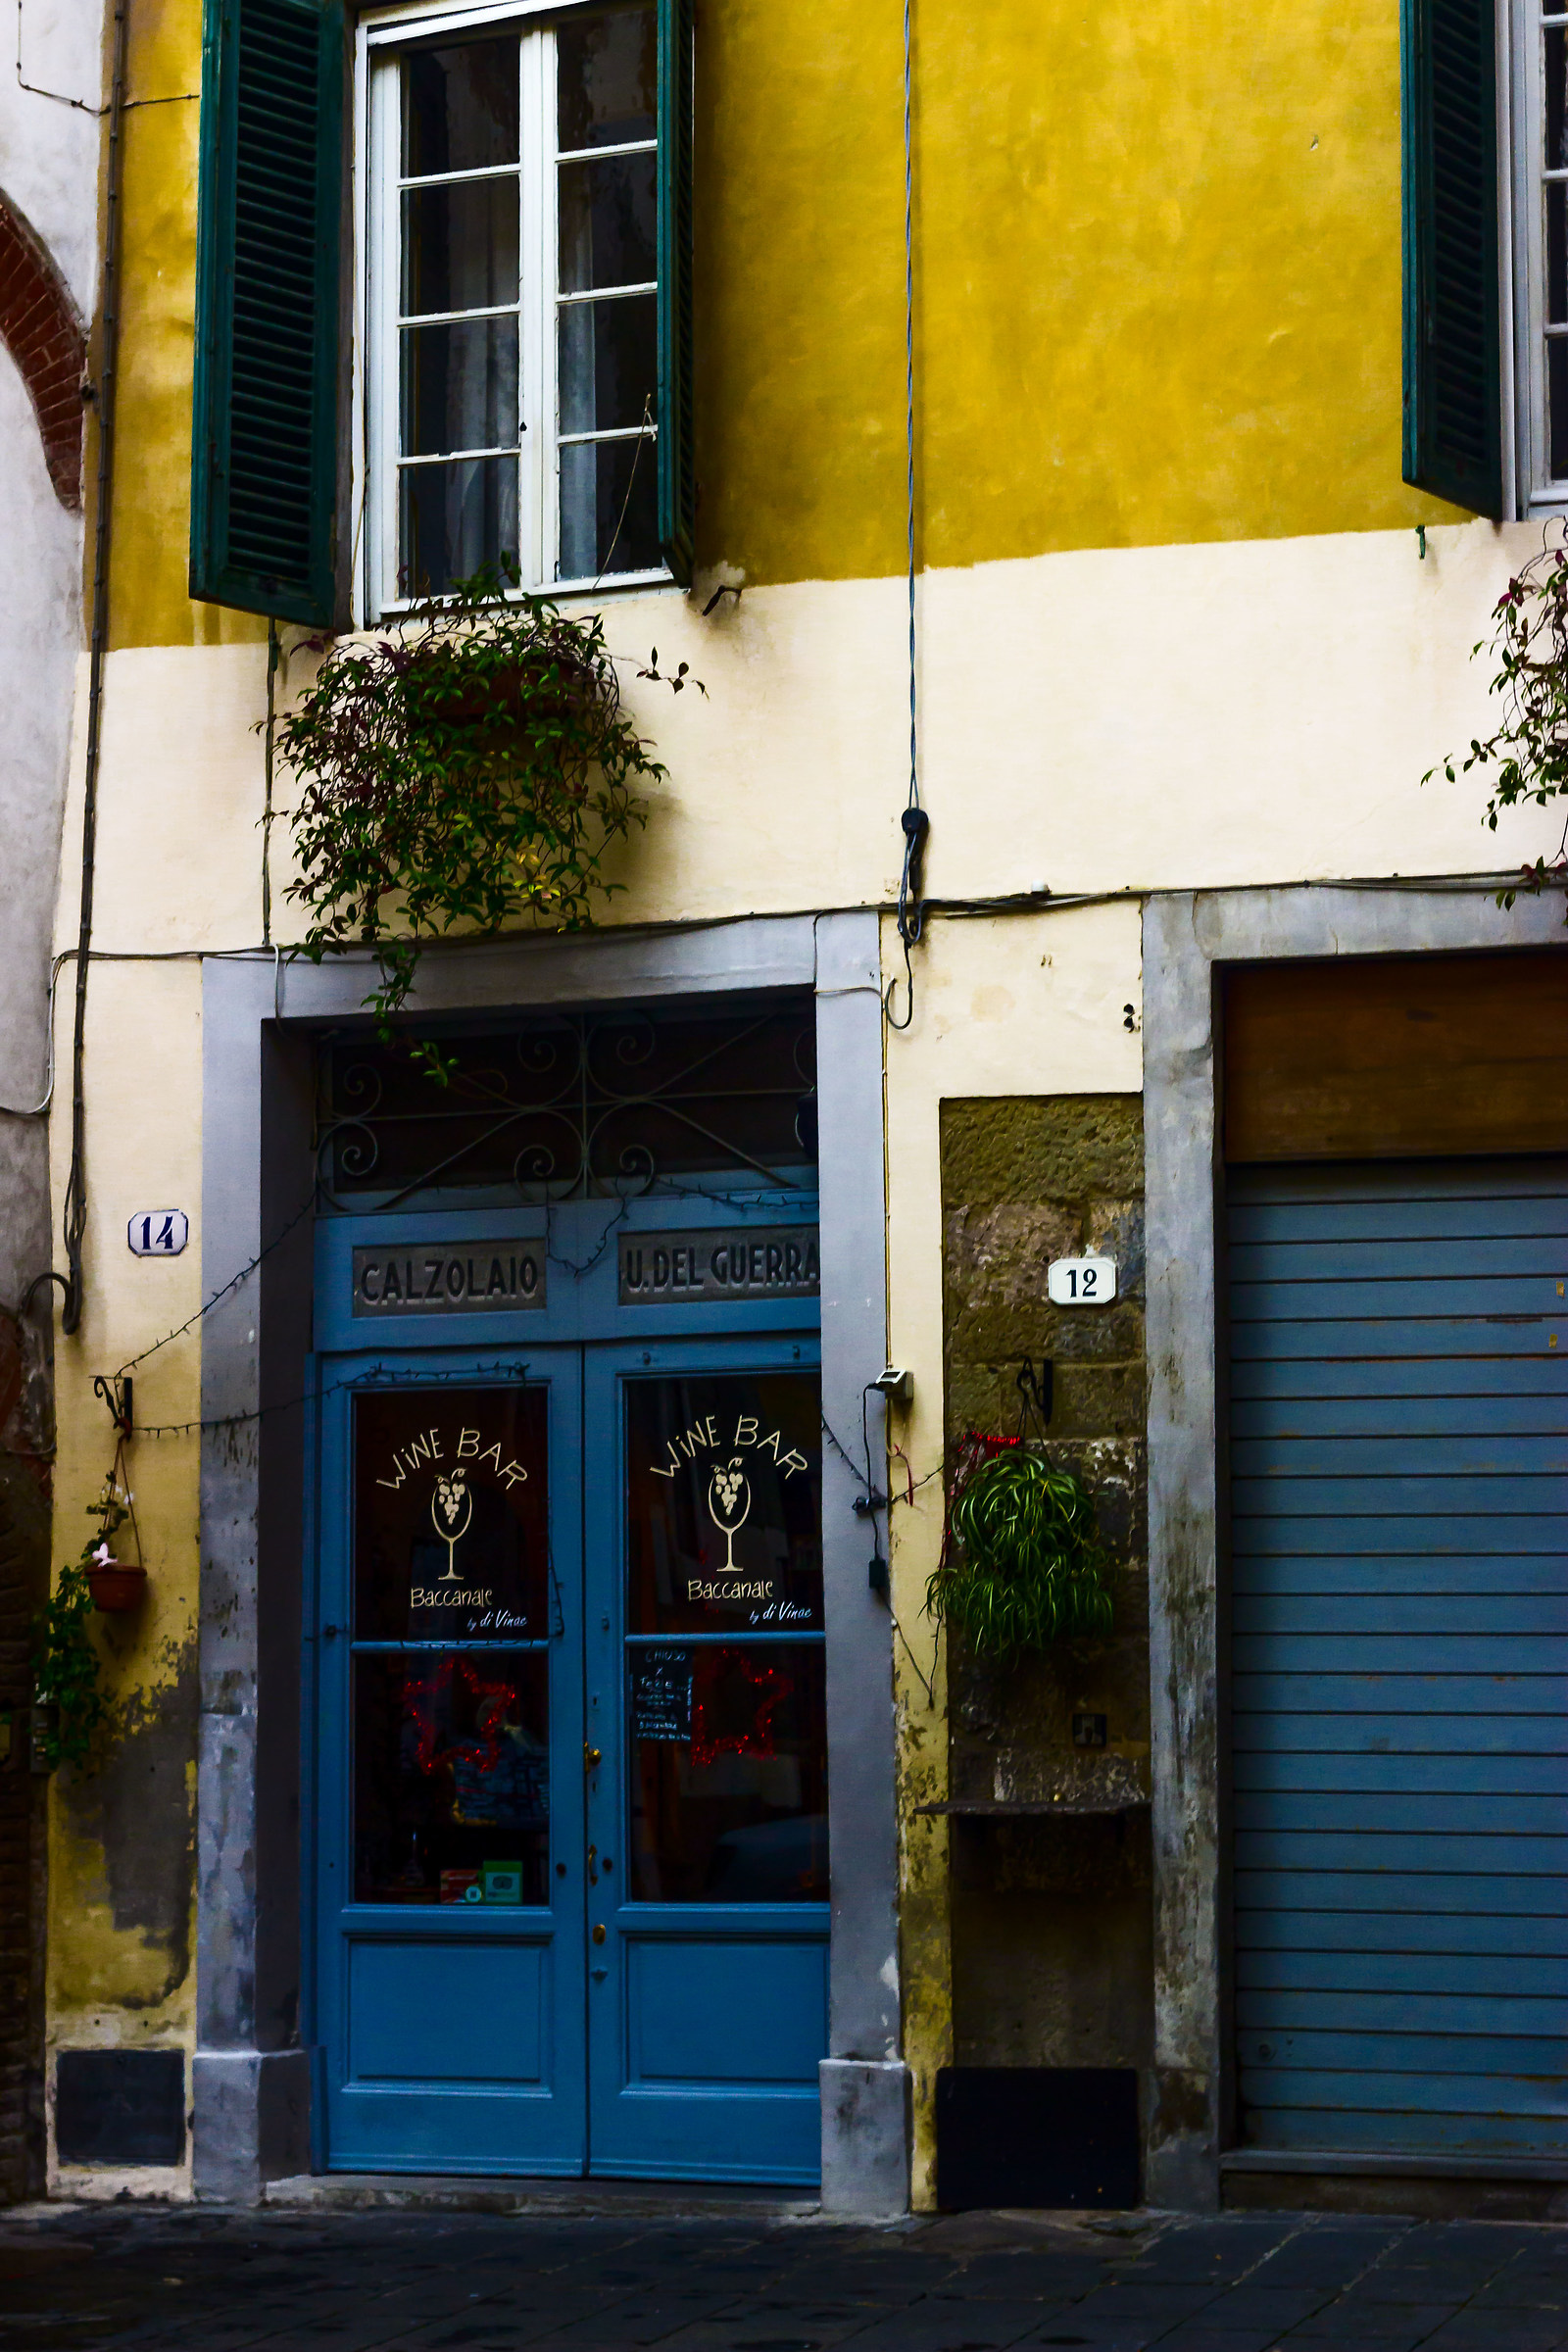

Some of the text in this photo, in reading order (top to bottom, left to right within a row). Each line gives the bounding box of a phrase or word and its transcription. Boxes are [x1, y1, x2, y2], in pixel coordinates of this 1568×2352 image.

[140, 1215, 173, 1250] 14
[360, 1255, 539, 1305] CALZOLAIO
[710, 1242, 821, 1289] GUERRA
[1065, 1268, 1098, 1298] 12
[456, 1427, 529, 1491] BAR
[733, 1414, 809, 1480] BAR
[410, 1587, 494, 1609] Baccanale
[687, 1579, 774, 1602] Baccanale
